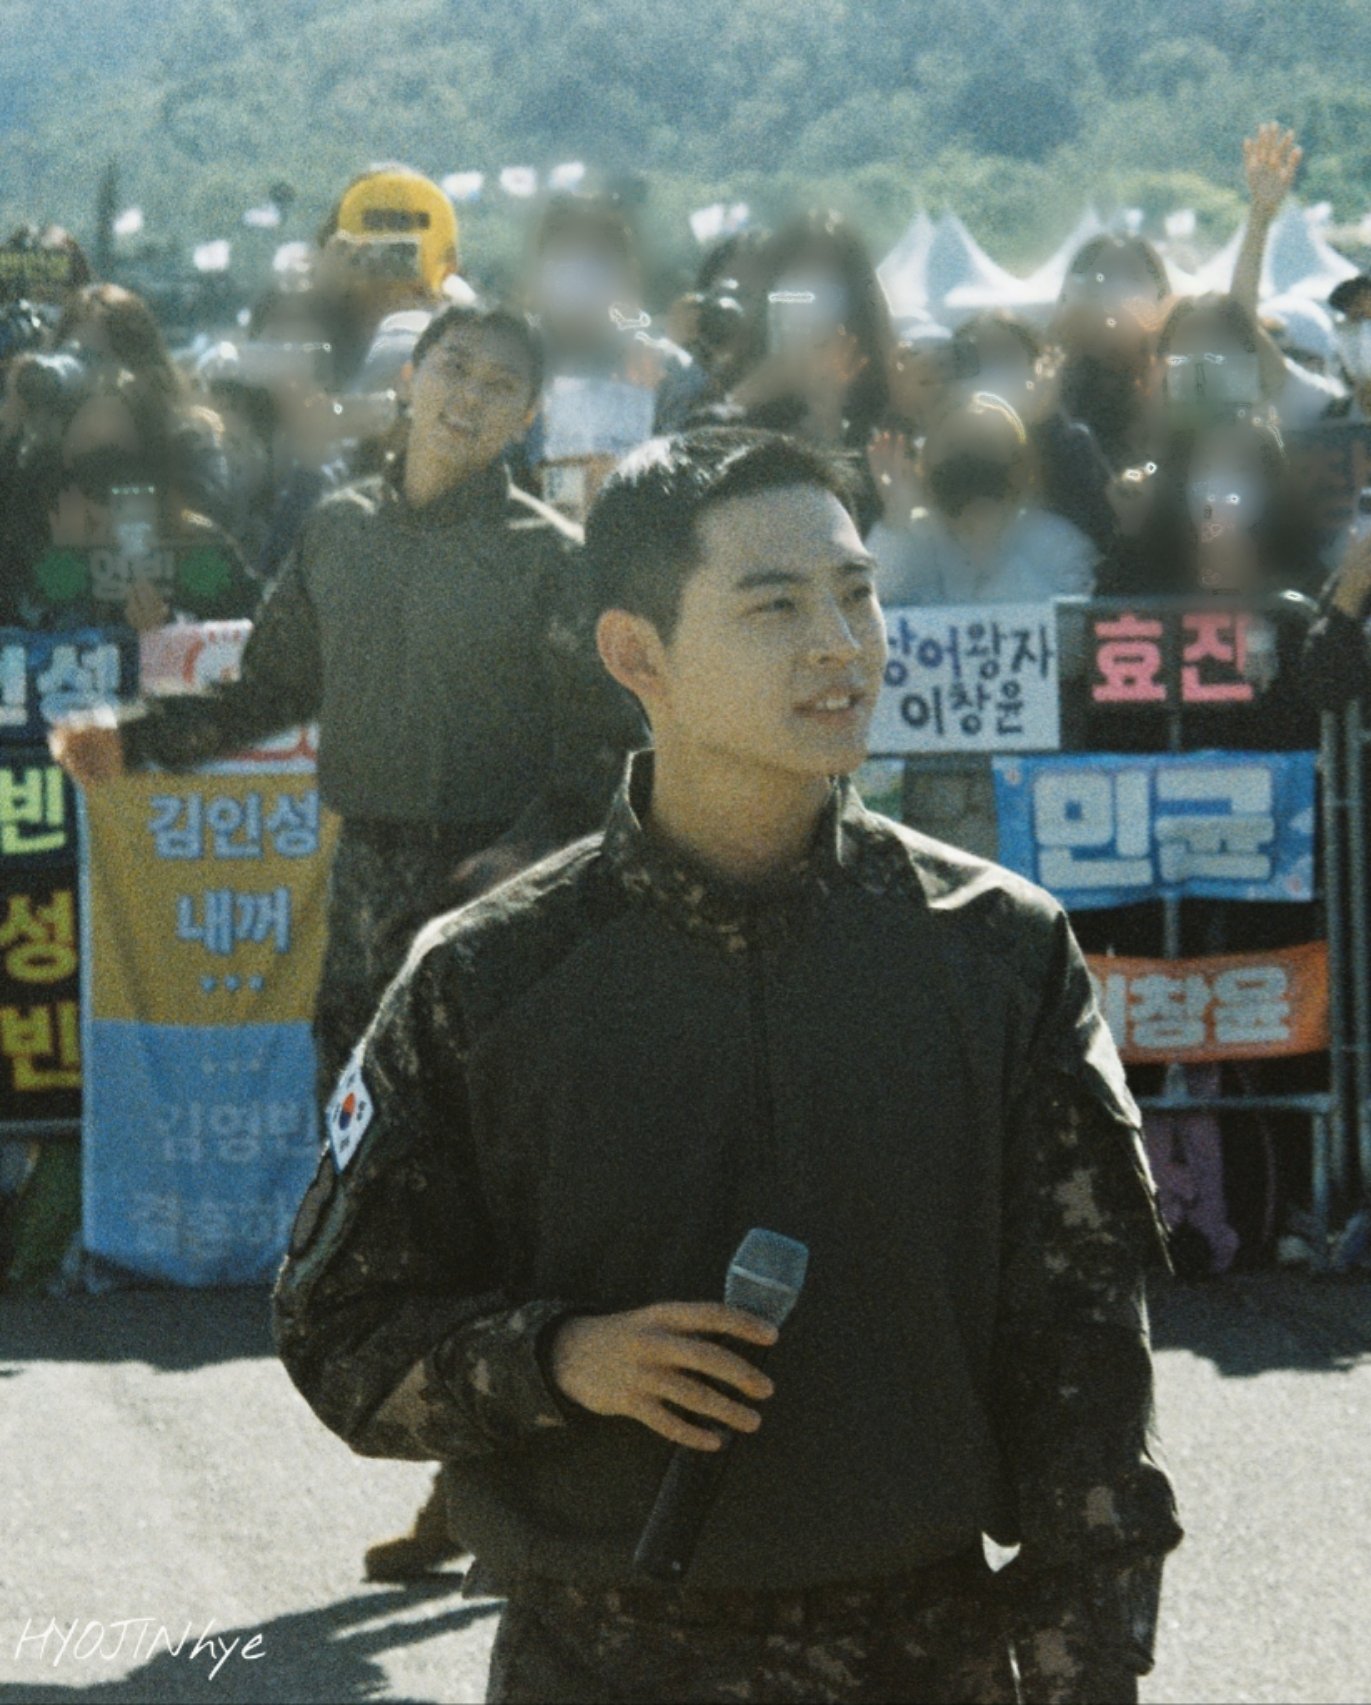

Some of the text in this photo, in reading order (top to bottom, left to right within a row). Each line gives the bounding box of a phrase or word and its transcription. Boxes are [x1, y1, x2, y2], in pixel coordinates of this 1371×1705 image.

[1092, 612, 1254, 703] 효진
[901, 679, 1024, 736] 이창윤
[149, 790, 320, 860] 김인성
[1033, 763, 1275, 888] 민균
[176, 886, 291, 954] 내꺼
